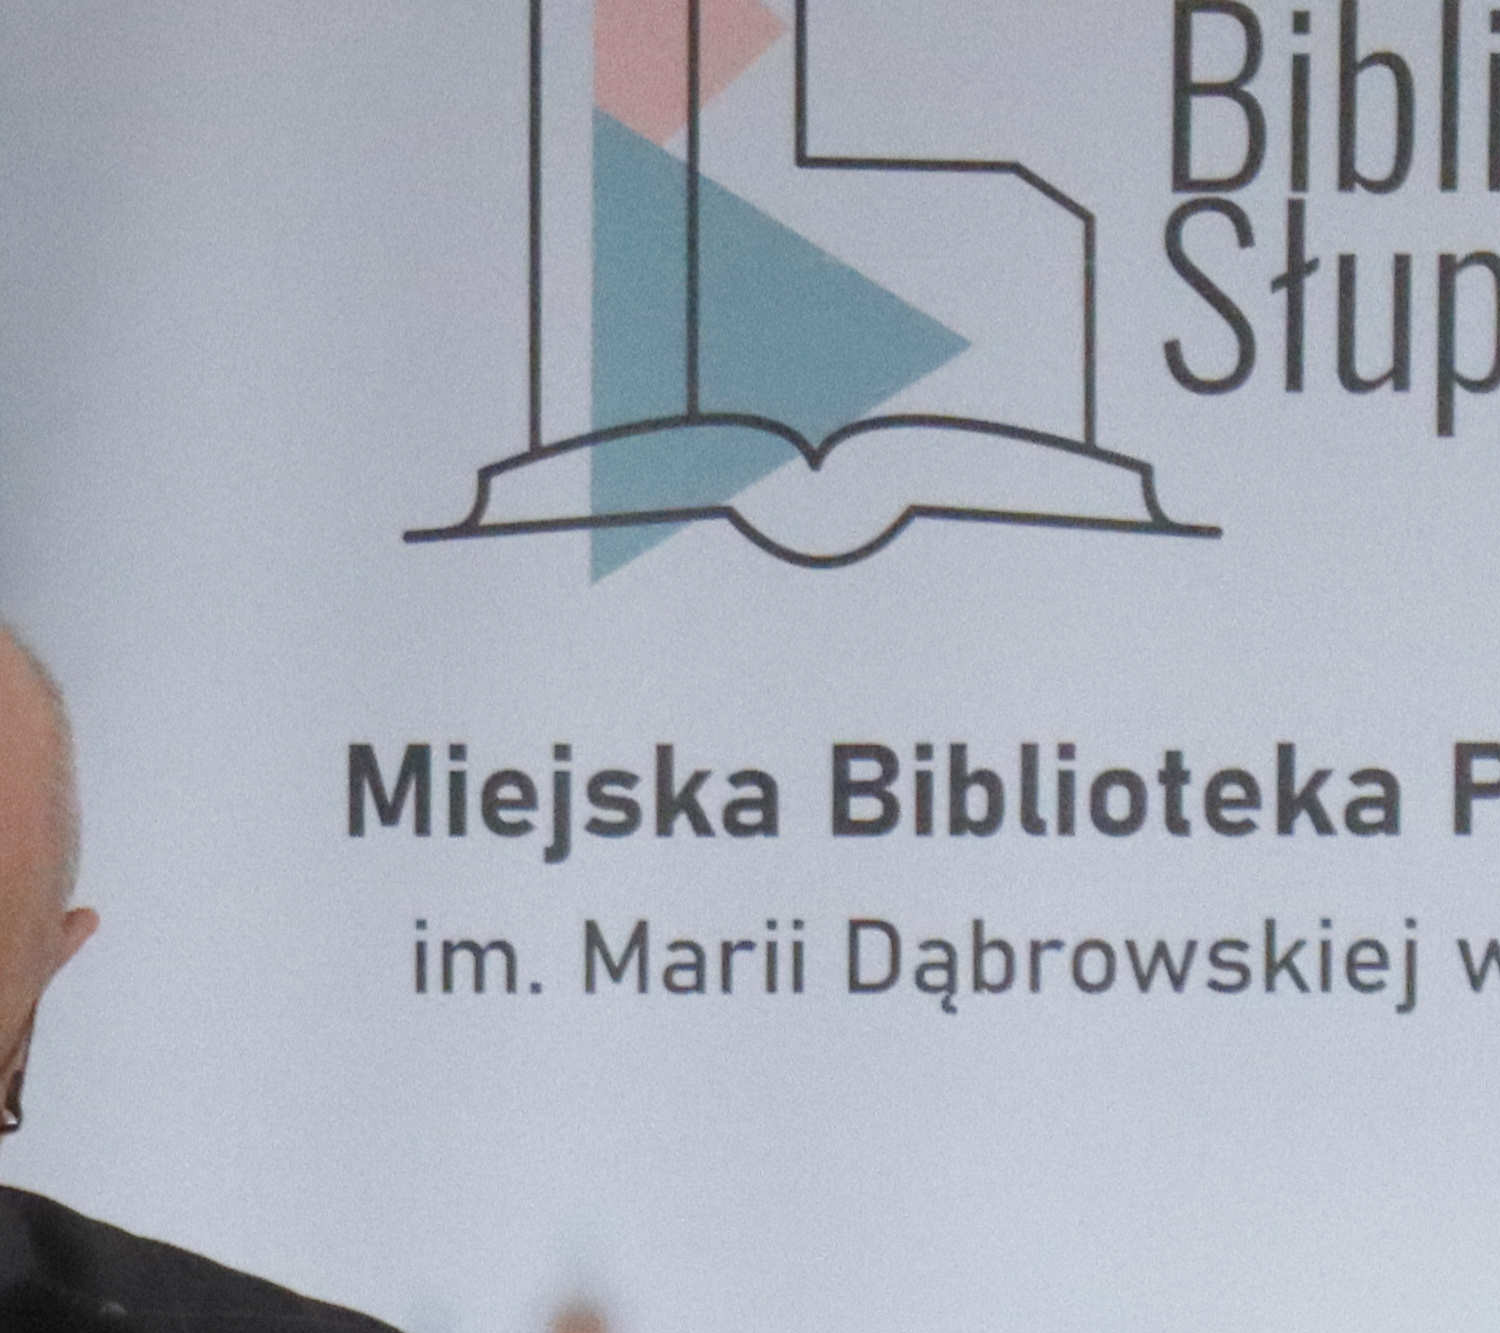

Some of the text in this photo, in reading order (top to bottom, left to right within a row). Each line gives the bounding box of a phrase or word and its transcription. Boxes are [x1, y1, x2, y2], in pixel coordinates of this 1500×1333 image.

[347, 742, 780, 863] Miejska
[830, 742, 1401, 838] Biblioteka
[413, 918, 541, 994] im.
[583, 918, 805, 995] Marii
[847, 918, 1417, 1014] Dąbrowskiej
